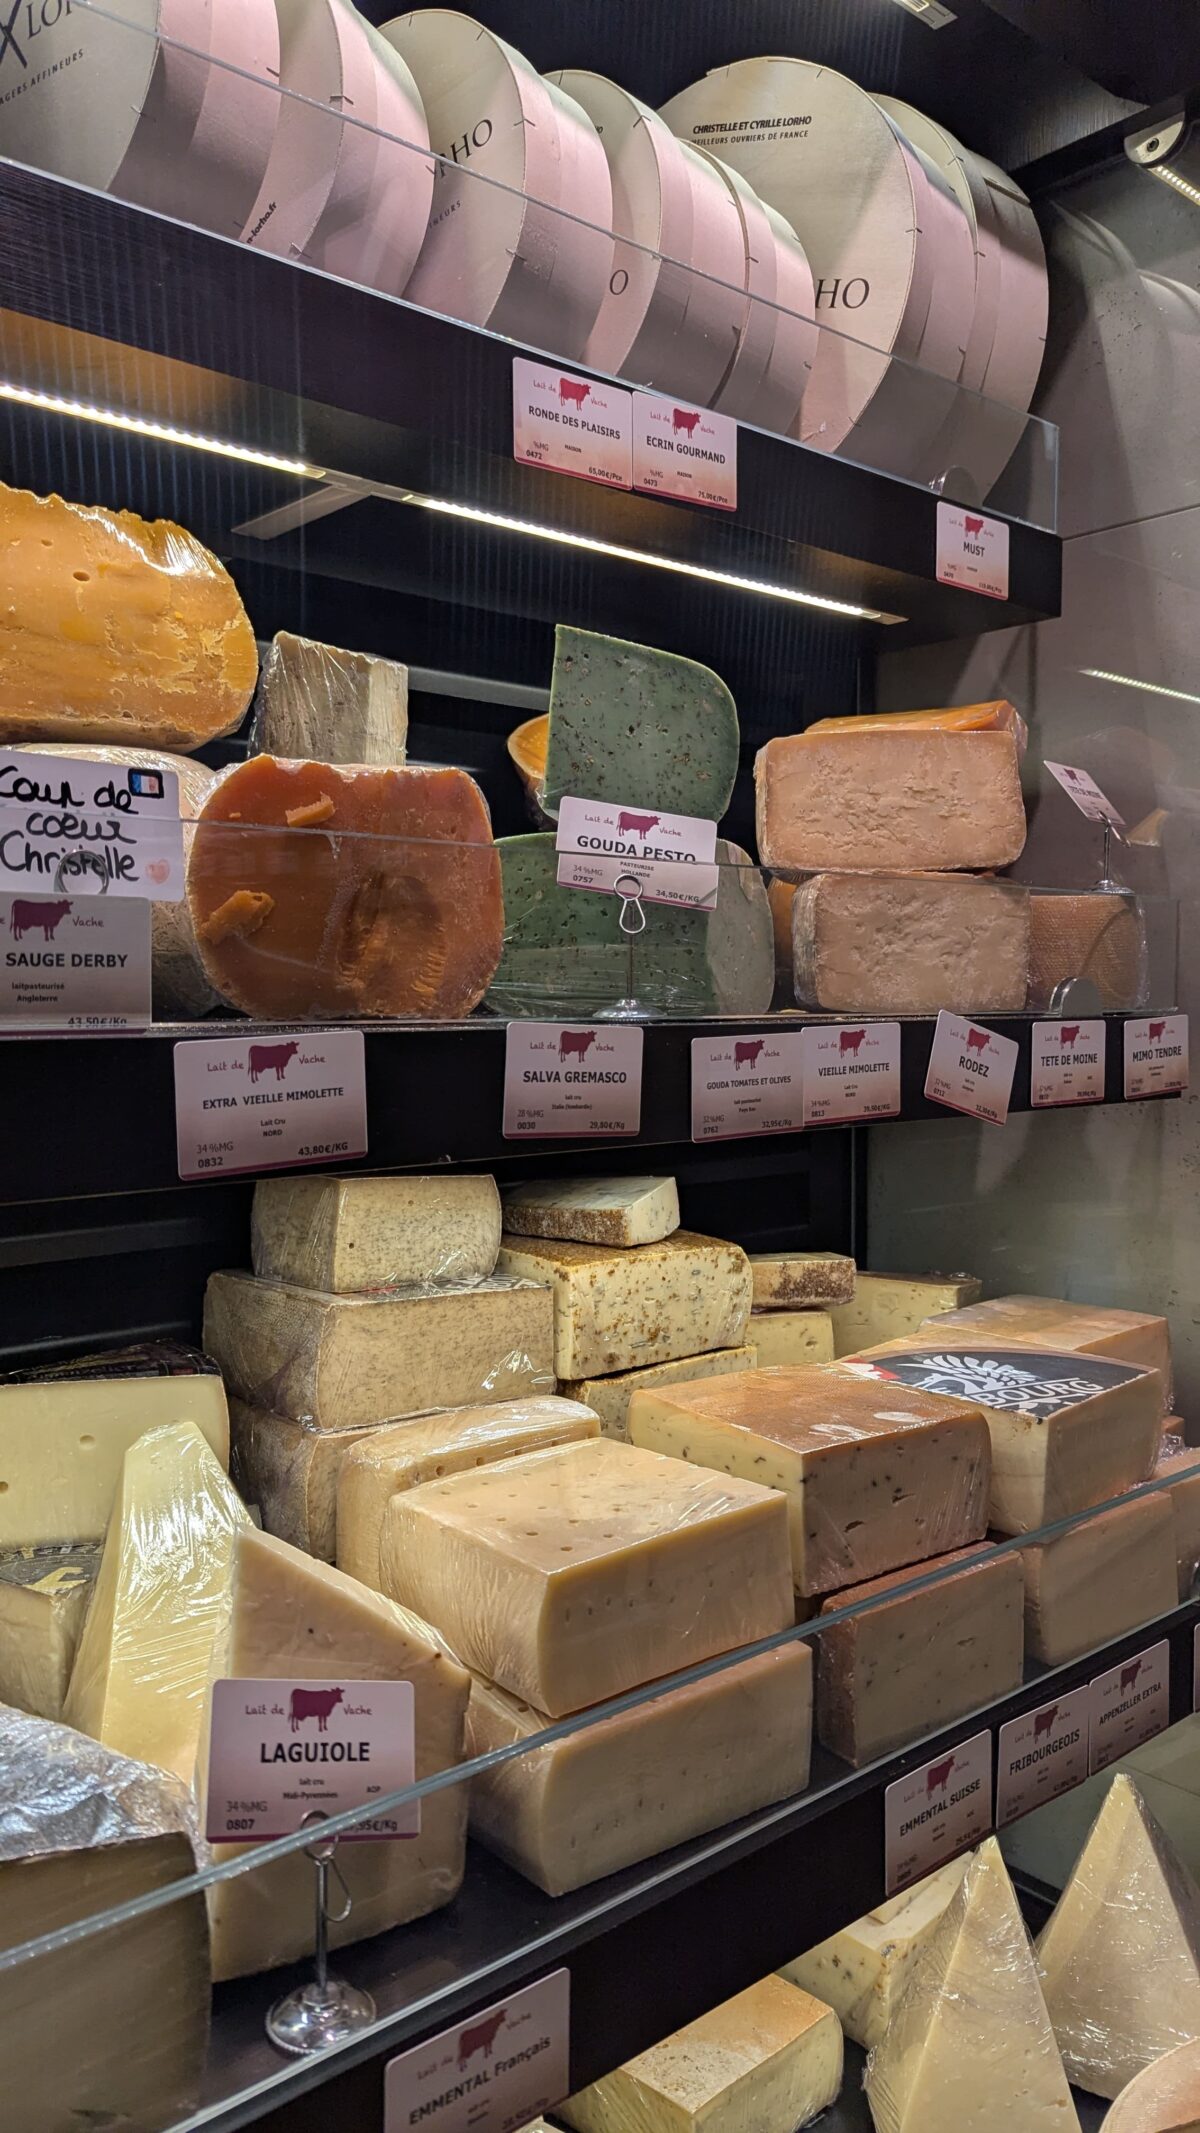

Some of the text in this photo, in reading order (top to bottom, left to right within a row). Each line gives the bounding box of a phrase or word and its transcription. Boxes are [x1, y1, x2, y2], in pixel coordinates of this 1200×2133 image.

[31, 48, 84, 87] AFFINEURS
[692, 116, 812, 135] CHRISTELLE ET CYRILLE LORHO
[731, 134, 765, 143] OUVRIERS
[780, 130, 808, 139] FRANCE
[533, 379, 608, 408] Lait de Vache
[529, 405, 620, 440] RONDE DES PLAISIRS
[650, 411, 661, 420] Lait
[526, 449, 543, 460] 0472
[646, 435, 726, 464] ECRIN GOURMAND
[643, 478, 658, 487] 0473
[963, 541, 985, 557] MUST
[584, 814, 682, 837] Lait de Vache
[577, 835, 696, 864] GOUDA PESTO
[572, 875, 593, 884] 0757
[655, 889, 700, 903] 34,50€/KG
[72, 916, 104, 928] Vache
[5, 952, 128, 968] SAUGE DERBY
[530, 1042, 615, 1052] Lait de Vache
[817, 1041, 830, 1049] Lait
[710, 1049, 780, 1062] Lait de Vache
[1041, 1053, 1098, 1067] TETE DE MOINE
[1132, 1045, 1182, 1062] MIMO TENDRE
[207, 1055, 326, 1072] Lait de Vache
[818, 1062, 890, 1077] VIEILLE MIMOLETTE
[958, 1055, 990, 1078] RODEZ
[523, 1070, 627, 1083] SALVA GREMASCO
[707, 1075, 792, 1090] GOUDA TOMATES ET OLIVES
[203, 1087, 344, 1110] EXTRA VIEILLE MIMOLETTE
[260, 1118, 286, 1127] Lait Cru
[262, 1129, 283, 1137] NORD
[298, 1142, 348, 1157] 43,80€/KG
[197, 1158, 223, 1169] 0832
[245, 1704, 373, 1716] Lait de Vache
[1099, 1694, 1141, 1726] APPENZELLER
[1142, 1682, 1162, 1698] EXTRA
[260, 1742, 370, 1763] LAGUIOLE
[1009, 1728, 1081, 1776] FRIBOURGEOIS
[900, 1799, 948, 1837] EMMENTAL
[950, 1778, 981, 1806] SUISSE
[226, 1819, 255, 1831] 0807
[409, 2070, 491, 2125] EMMENTAL
[494, 2036, 551, 2077] Français
